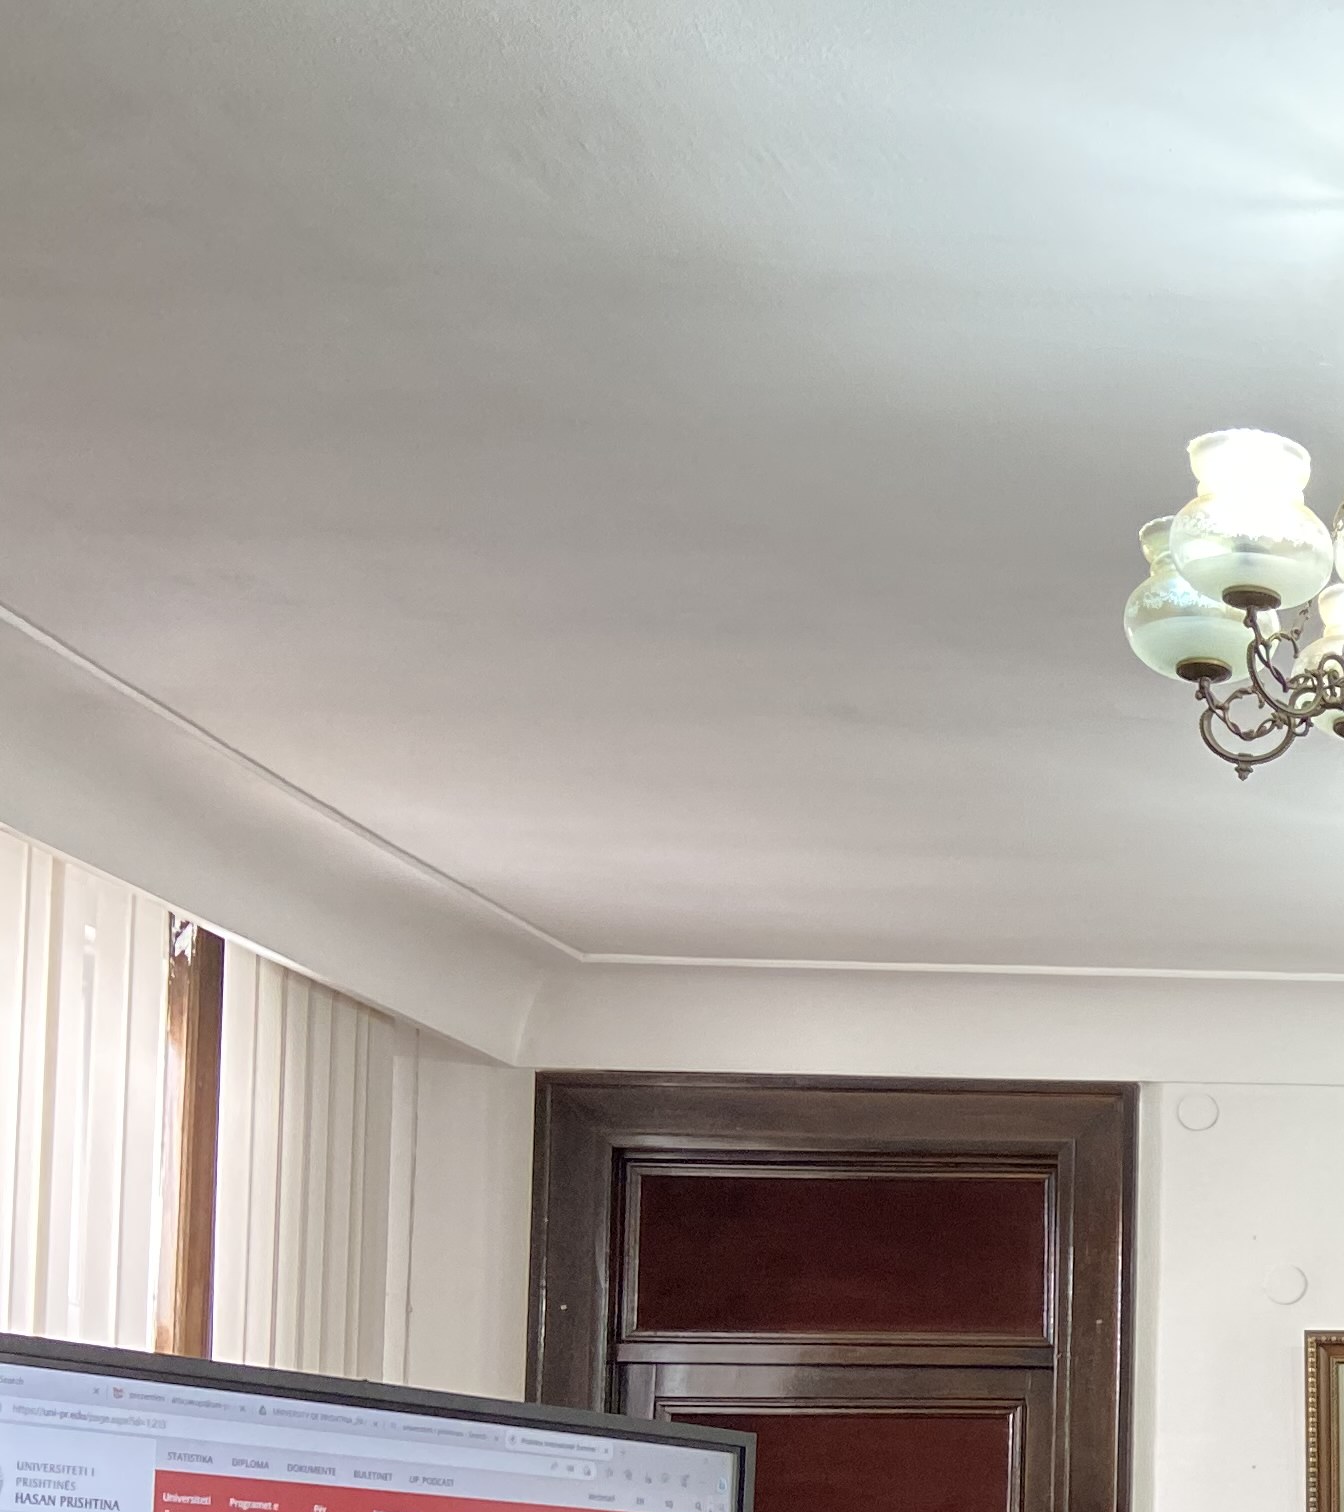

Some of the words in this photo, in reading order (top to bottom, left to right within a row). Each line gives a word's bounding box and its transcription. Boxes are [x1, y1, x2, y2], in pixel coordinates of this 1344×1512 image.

[167, 1451, 213, 1464] STATISTIKA
[231, 1457, 270, 1470] DIPLOMA
[16, 1460, 88, 1476] UNIVERSITETI
[286, 1463, 336, 1477] DOKUMENTE
[14, 1492, 56, 1507] HASAN
[59, 1495, 120, 1512] PRISHTINA
